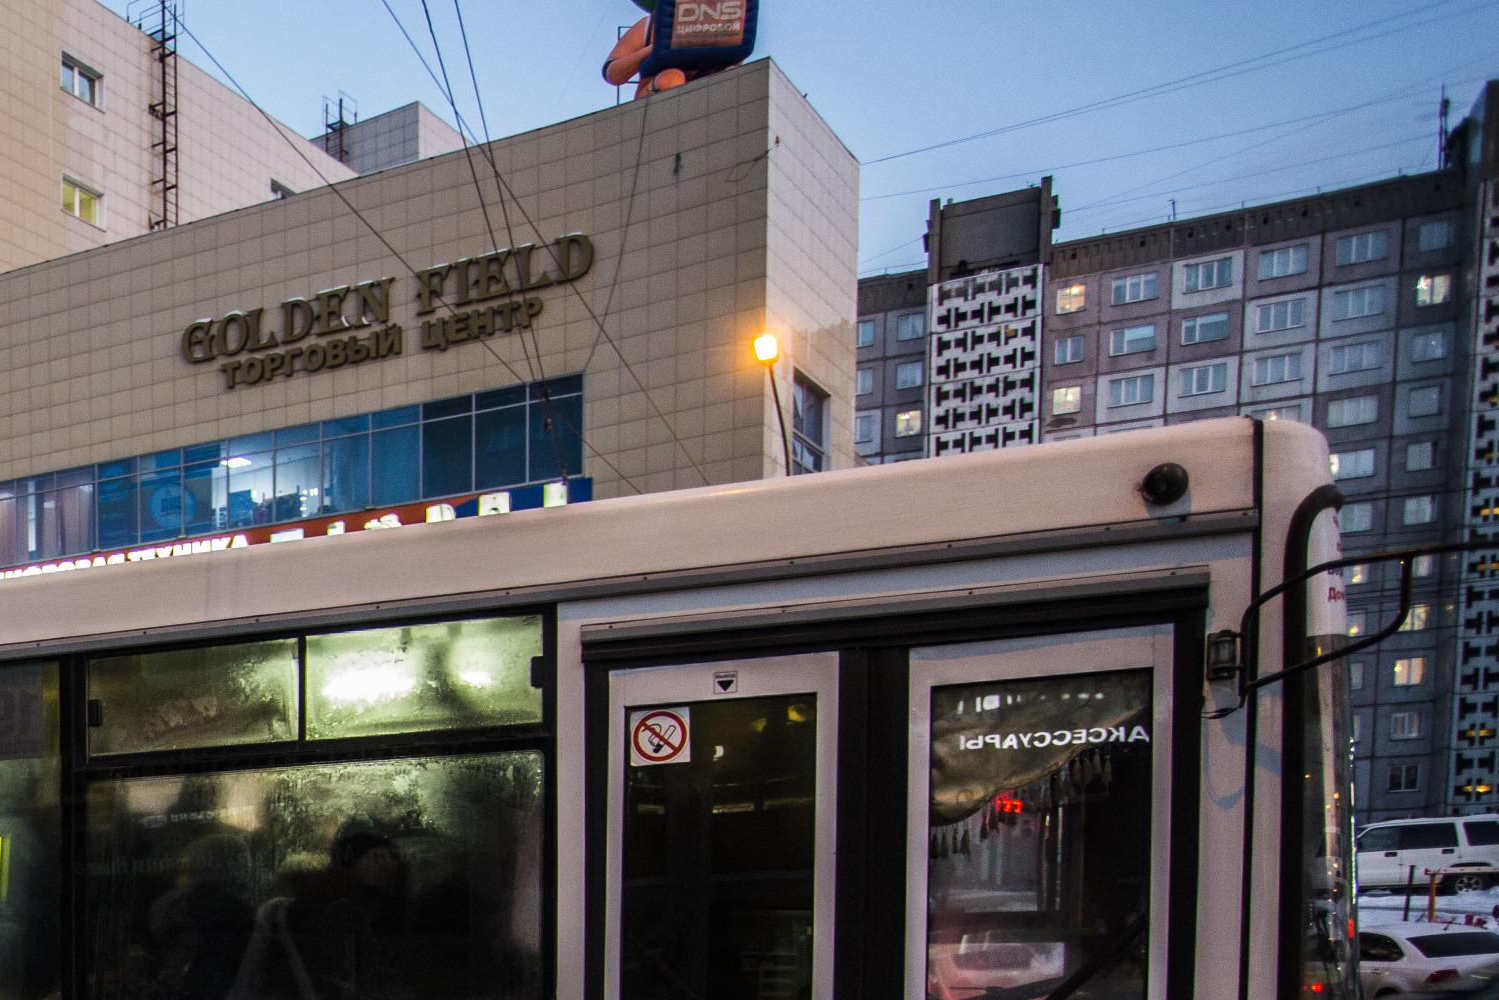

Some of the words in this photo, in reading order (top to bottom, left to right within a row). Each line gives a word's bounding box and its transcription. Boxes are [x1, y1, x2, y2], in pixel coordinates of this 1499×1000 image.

[678, 2, 741, 22] DNS
[181, 277, 395, 364] GOLDEN
[417, 232, 595, 317] FIELD
[221, 323, 402, 389] ТОРГОВЫЙ
[421, 297, 543, 351] ЦЕНТР
